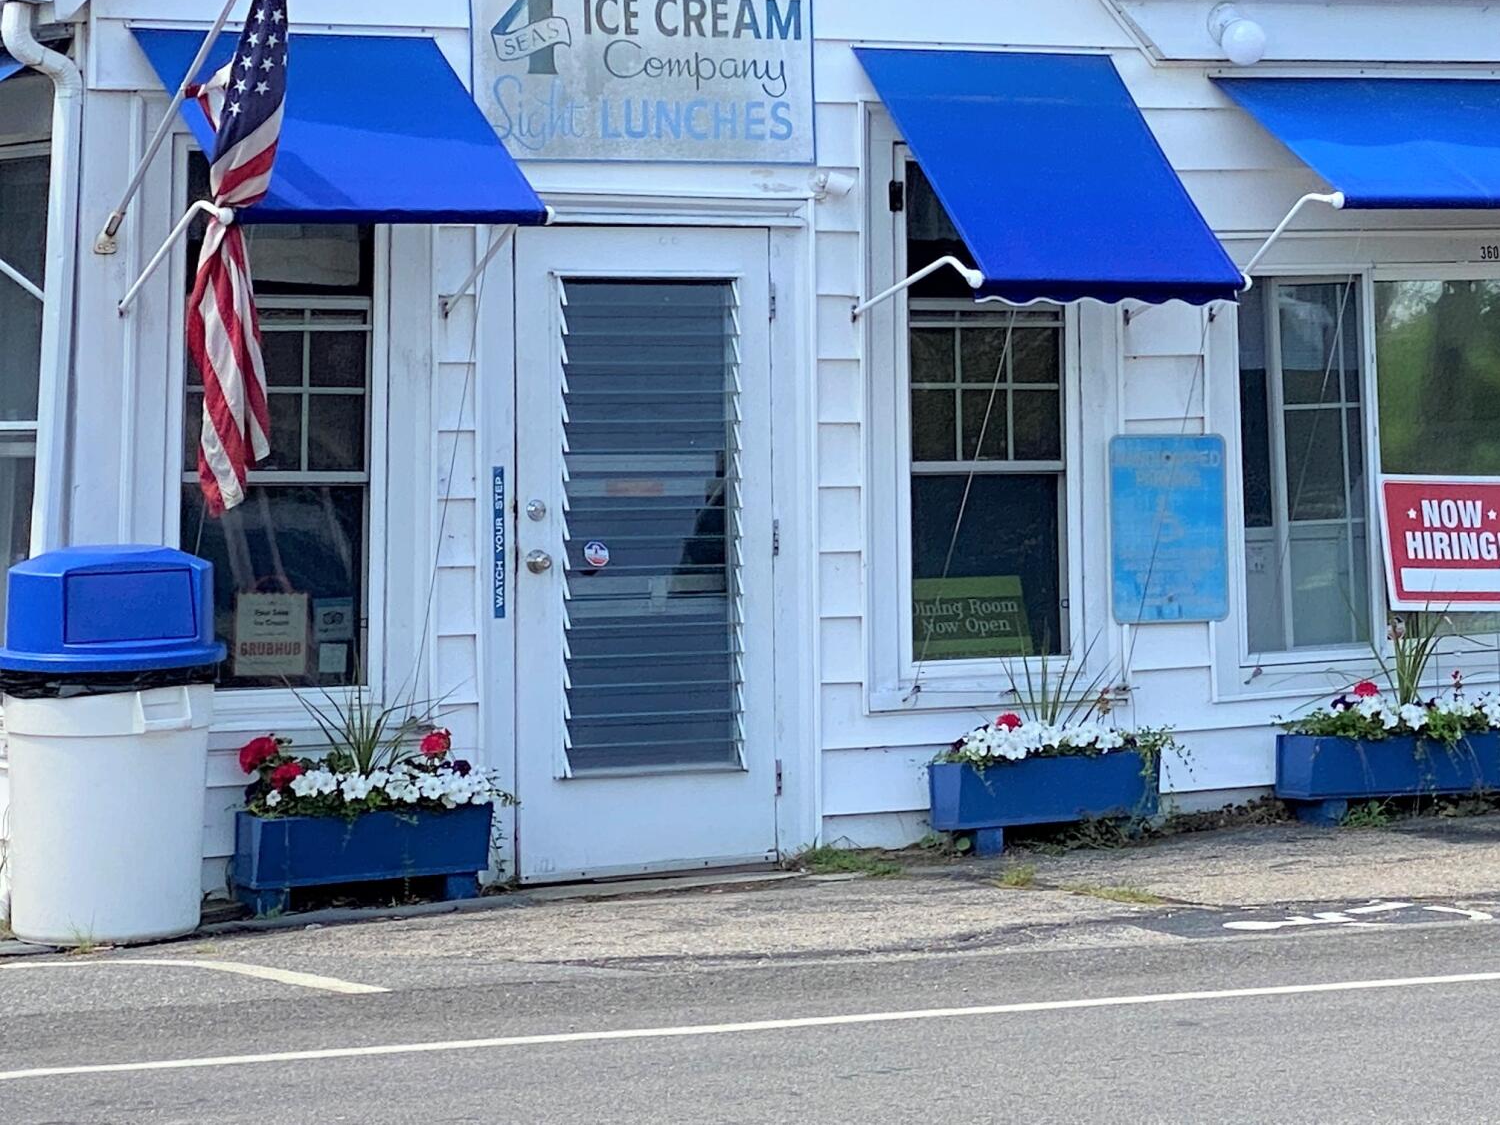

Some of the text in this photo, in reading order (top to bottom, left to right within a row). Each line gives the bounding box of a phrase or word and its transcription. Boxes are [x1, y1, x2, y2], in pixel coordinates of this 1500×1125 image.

[504, 22, 560, 56] SEAS
[603, 40, 788, 98] Company
[601, 98, 794, 141] LUNCHES
[1480, 245, 1499, 260] 360
[1420, 500, 1483, 528] NOW
[493, 476, 504, 608] WATCH YOUR STEP
[968, 598, 1018, 616] Room
[922, 618, 1012, 637] Now Open
[240, 641, 301, 656] GRUBHUB
